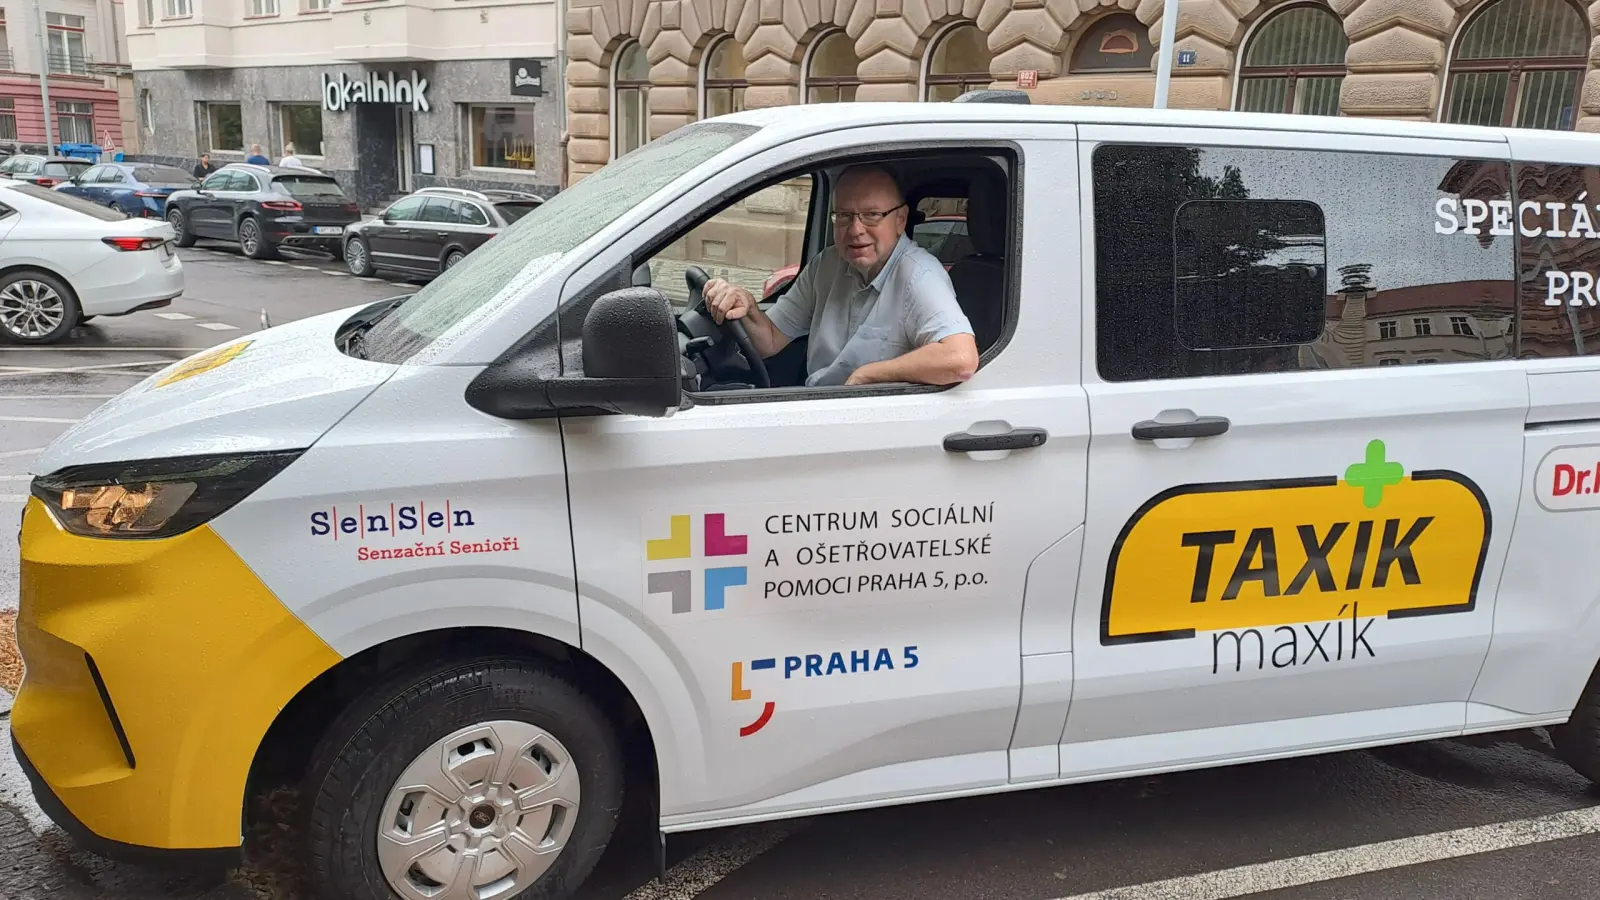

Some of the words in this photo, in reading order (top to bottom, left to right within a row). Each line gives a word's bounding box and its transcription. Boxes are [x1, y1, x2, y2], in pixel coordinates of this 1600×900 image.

[1183, 54, 1190, 63] 11
[1435, 191, 1600, 238] SPECIÁ
[1545, 271, 1600, 306] PR
[1552, 461, 1600, 496] Dr.
[765, 511, 878, 534] CENTRUM
[891, 501, 995, 528] SOCIÁLNÍ
[358, 541, 445, 561] Senzační
[450, 537, 519, 554] Senioři
[765, 549, 779, 567] A
[796, 533, 992, 566] OŠETŘOVATELSKÉ
[764, 576, 851, 599] POMOCI
[857, 571, 927, 592] PRAHA
[933, 571, 948, 589] 5,
[954, 572, 988, 590] p.o.
[1212, 601, 1375, 674] maxík
[784, 648, 894, 679] PRAHA
[904, 646, 919, 669] 5
